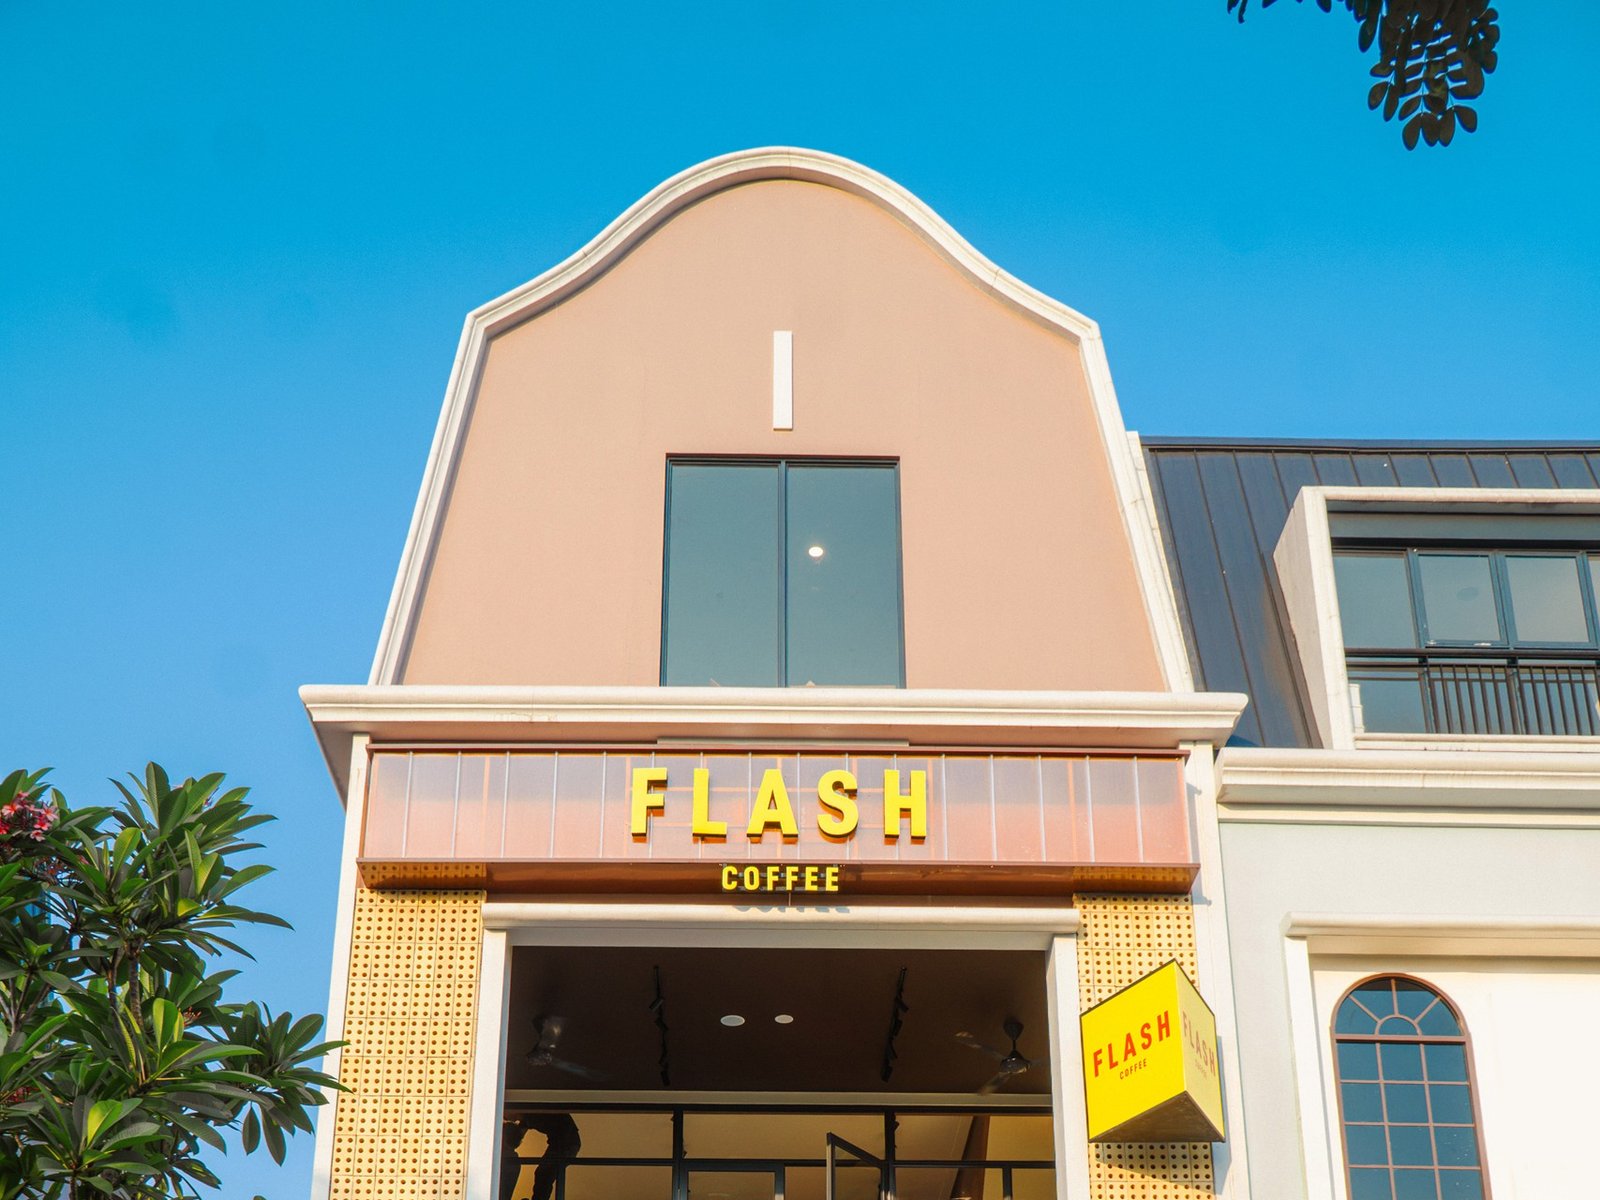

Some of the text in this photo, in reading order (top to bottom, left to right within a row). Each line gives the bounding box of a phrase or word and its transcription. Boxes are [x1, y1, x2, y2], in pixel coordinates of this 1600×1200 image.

[631, 768, 927, 840] FLASH
[721, 866, 840, 893] COFFEE
[1093, 1011, 1171, 1078] FLASH
[1119, 1058, 1148, 1080] COFFEE
[1182, 1010, 1216, 1077] FLASH
